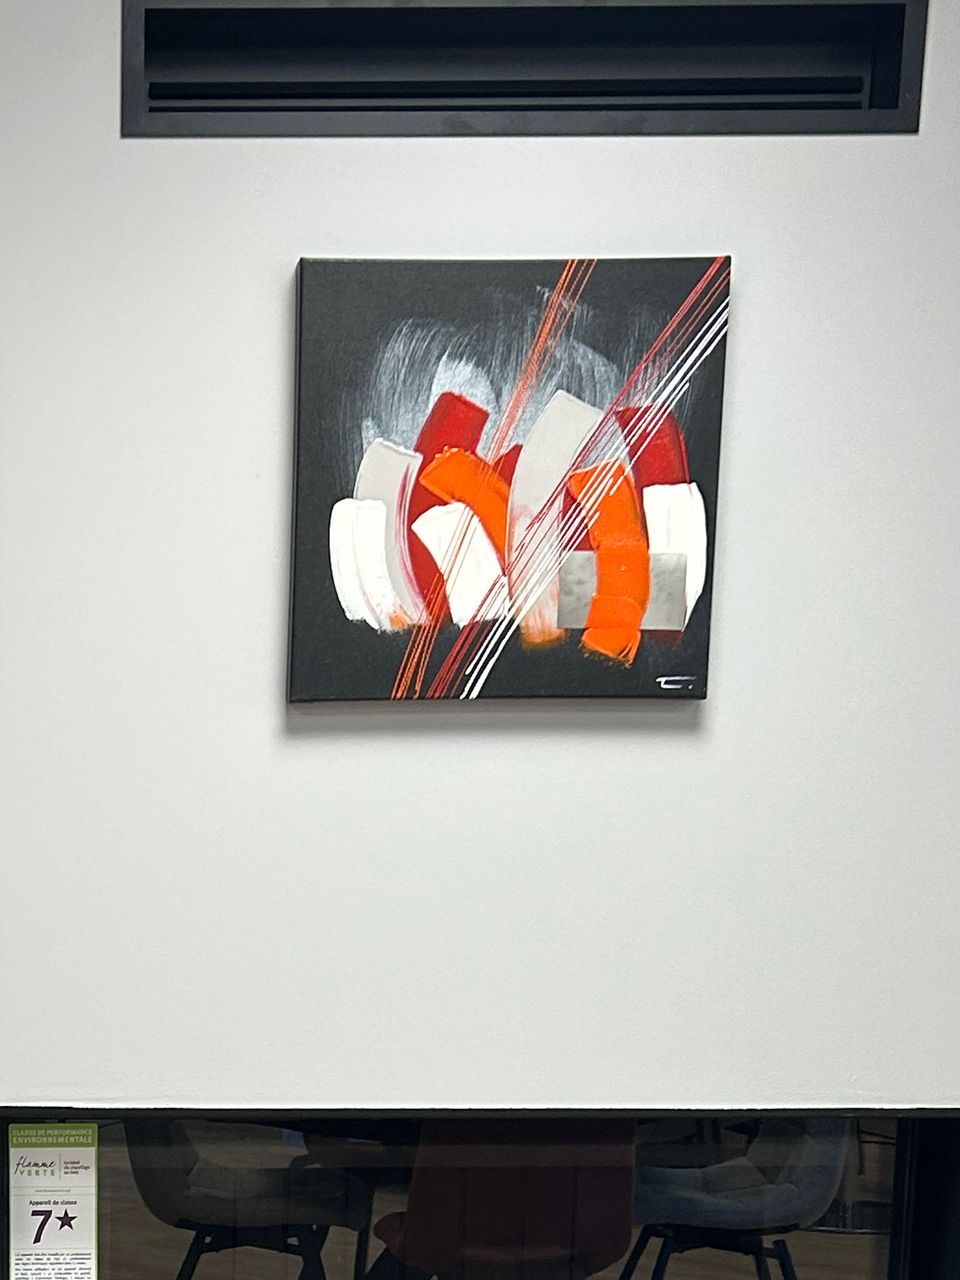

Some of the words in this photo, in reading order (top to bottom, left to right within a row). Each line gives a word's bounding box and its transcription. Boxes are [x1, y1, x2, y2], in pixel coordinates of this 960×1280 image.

[13, 1136, 92, 1144] ENVIRONNEMENTALE
[20, 1169, 56, 1177] VERTE
[31, 1210, 53, 1245] 7
